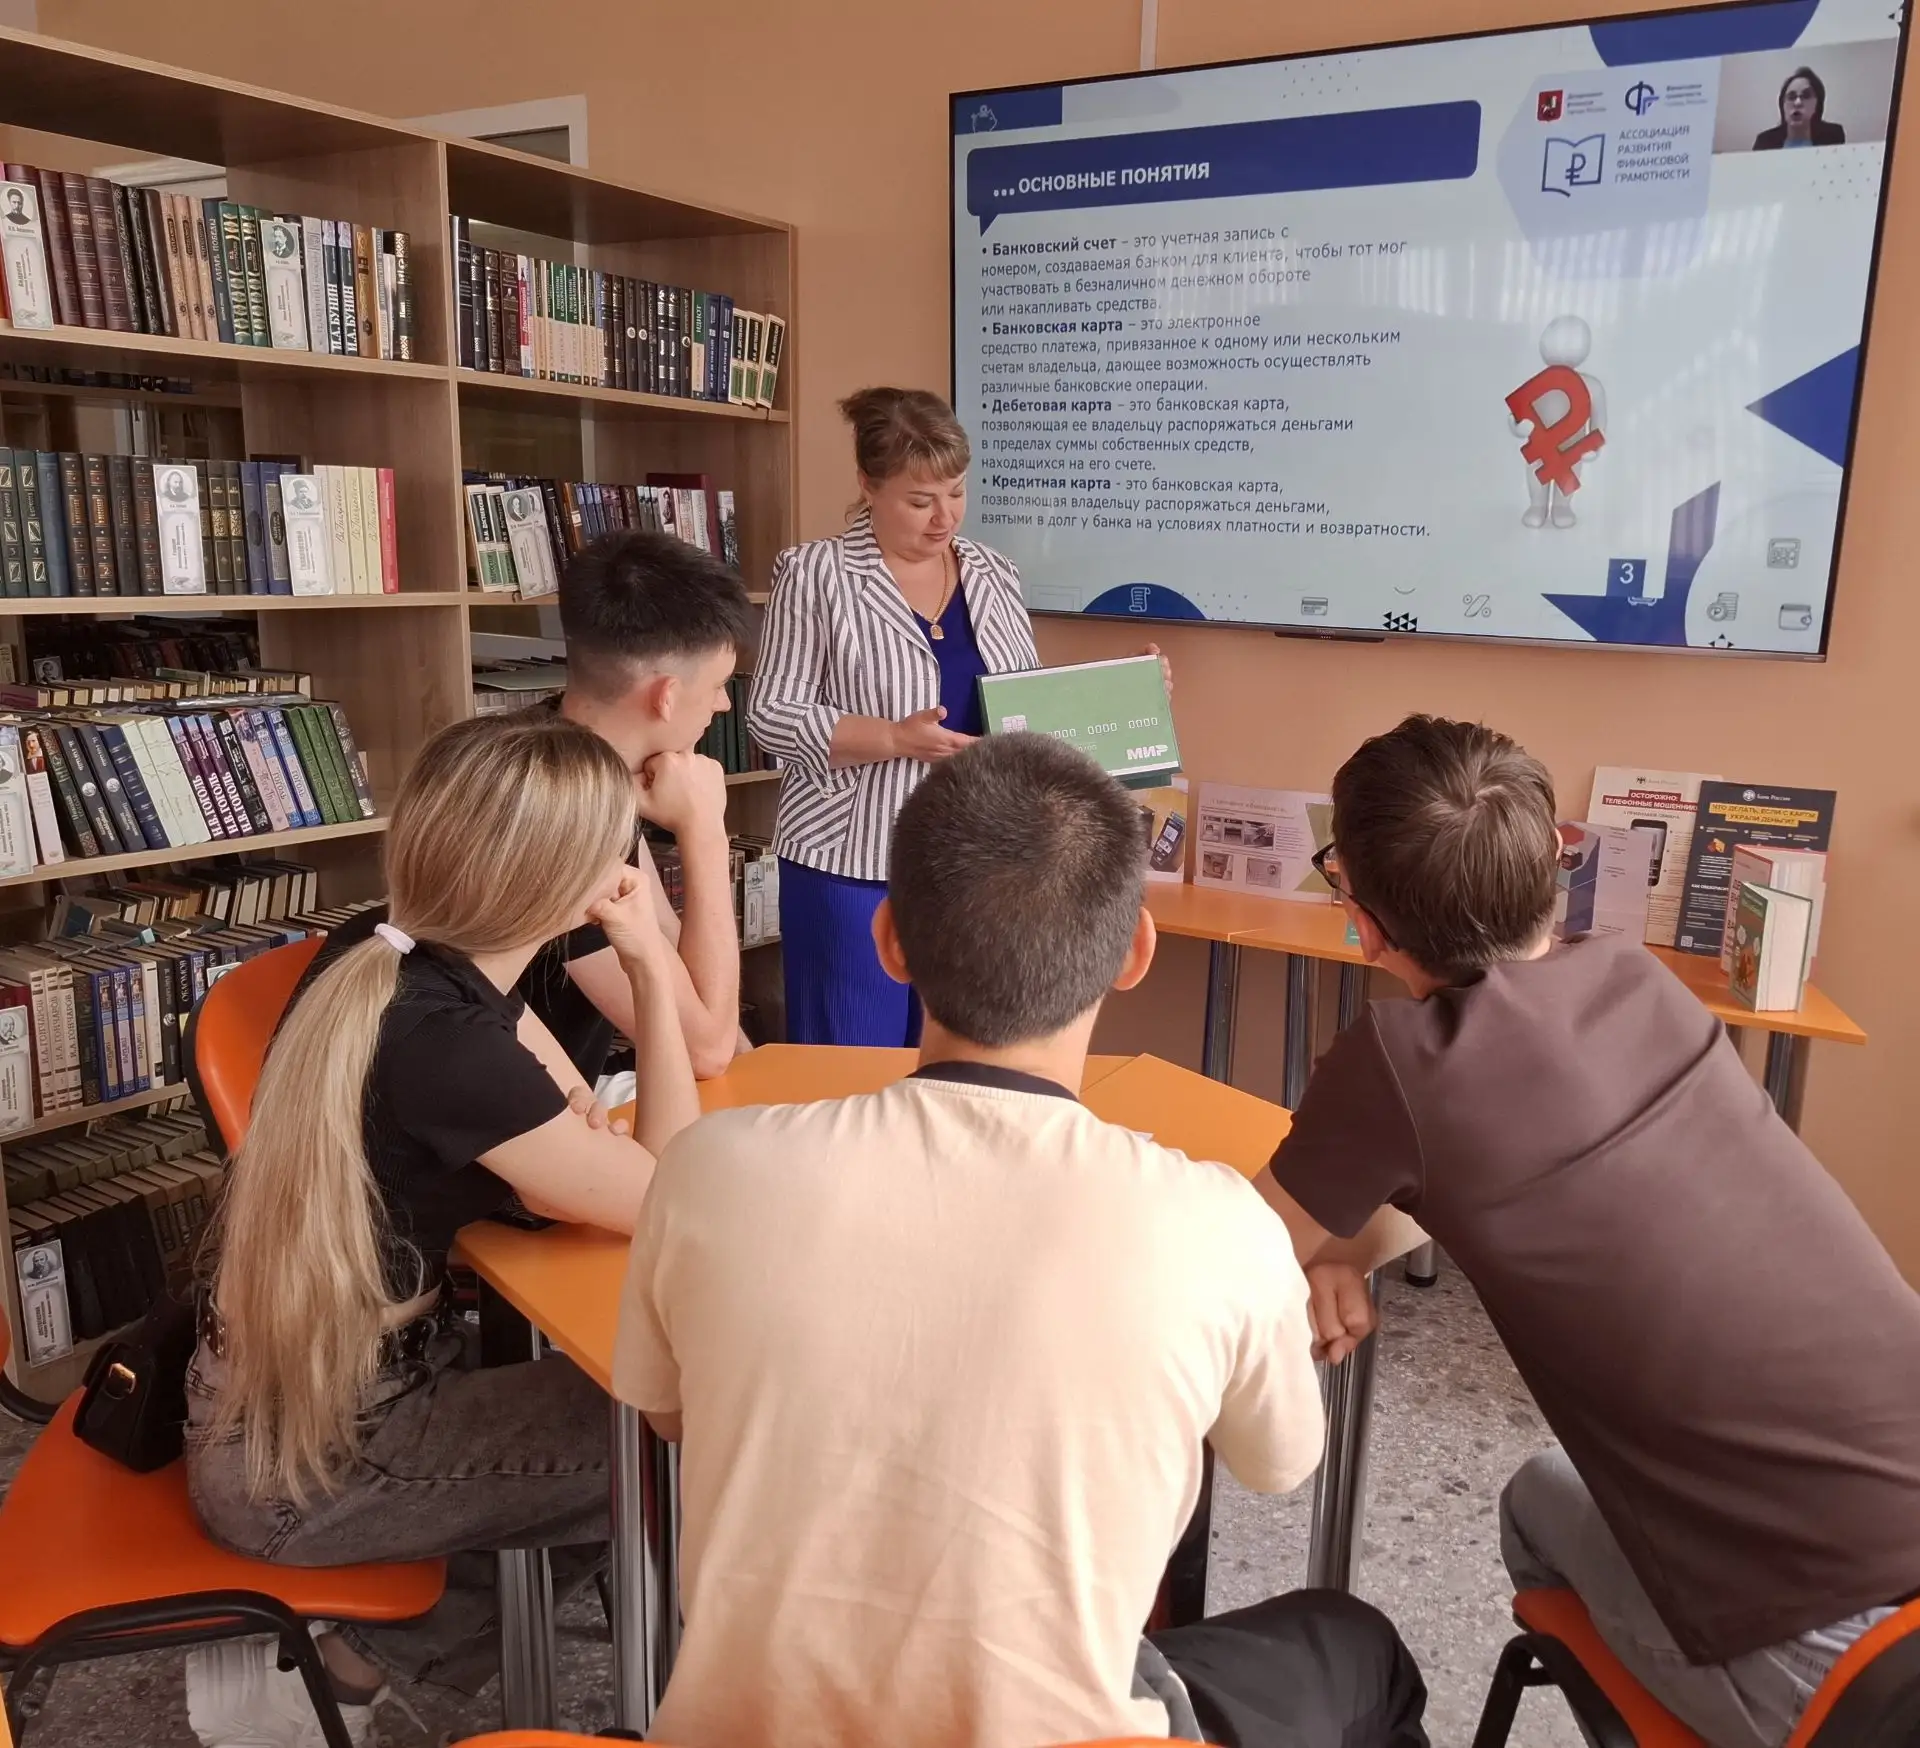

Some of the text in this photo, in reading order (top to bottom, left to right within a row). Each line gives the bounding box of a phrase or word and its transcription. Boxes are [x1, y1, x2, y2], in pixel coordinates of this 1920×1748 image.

[1619, 125, 1690, 140] АССОЦИАЦИЯ
[1617, 141, 1671, 154] РАЗВИТИЯ
[1617, 154, 1689, 169] ФИНАНСОВОЙ
[1122, 162, 1210, 186] ПОНЯТИЯ
[1615, 169, 1690, 183] ГРАМОТНОСТИ
[210, 218, 223, 282] АЛТАРЬ ПОБЕДЫ
[993, 227, 1289, 256] Банковский счет это учетная запись с
[981, 241, 1407, 279] номером, создаваемая банком для клиента, чтобы тот мог
[981, 269, 1310, 299] участвовать в безналичном денежном обороте
[327, 283, 340, 325] БУНИН
[343, 285, 356, 327] БУНИН
[981, 296, 1161, 315] или накапливать средства.
[993, 315, 1260, 335] Банковская карта это электронное
[982, 330, 1400, 358] средство платежа, привязанное к одному или нескольким
[982, 354, 1371, 374] счетам владельца, дающее возможность осуществлять
[982, 379, 1207, 396] различные банковские операции.
[992, 397, 1289, 414] Дебетовая карта это банковская карта,
[982, 418, 1353, 434] позволяющая ее владельцу распоряжаться деньгами
[982, 437, 1253, 453] в пределах суммы собственных средств,
[982, 458, 1155, 470] находящихся на его счете.
[992, 476, 1283, 495] Кредитная карта это банковская карта,
[478, 495, 488, 528] ДОСТОЕВСКИЙ
[982, 495, 1330, 515] позволяющая владельцу распоряжаться деньгами,
[982, 513, 1430, 538] взятыми в долг у банка на условиях платности и возвратности.
[1619, 563, 1634, 583] 3
[1088, 723, 1117, 734] 0000
[1128, 718, 1158, 728] 0000
[1127, 745, 1168, 760] МИР
[1605, 798, 1652, 807] ТЕЛЕФОННЫЕ
[1630, 792, 1678, 801] ОСТОРОЖНО:
[1730, 814, 1760, 822] УКРАЛИ
[179, 960, 189, 1002] ОБЛОМОВ
